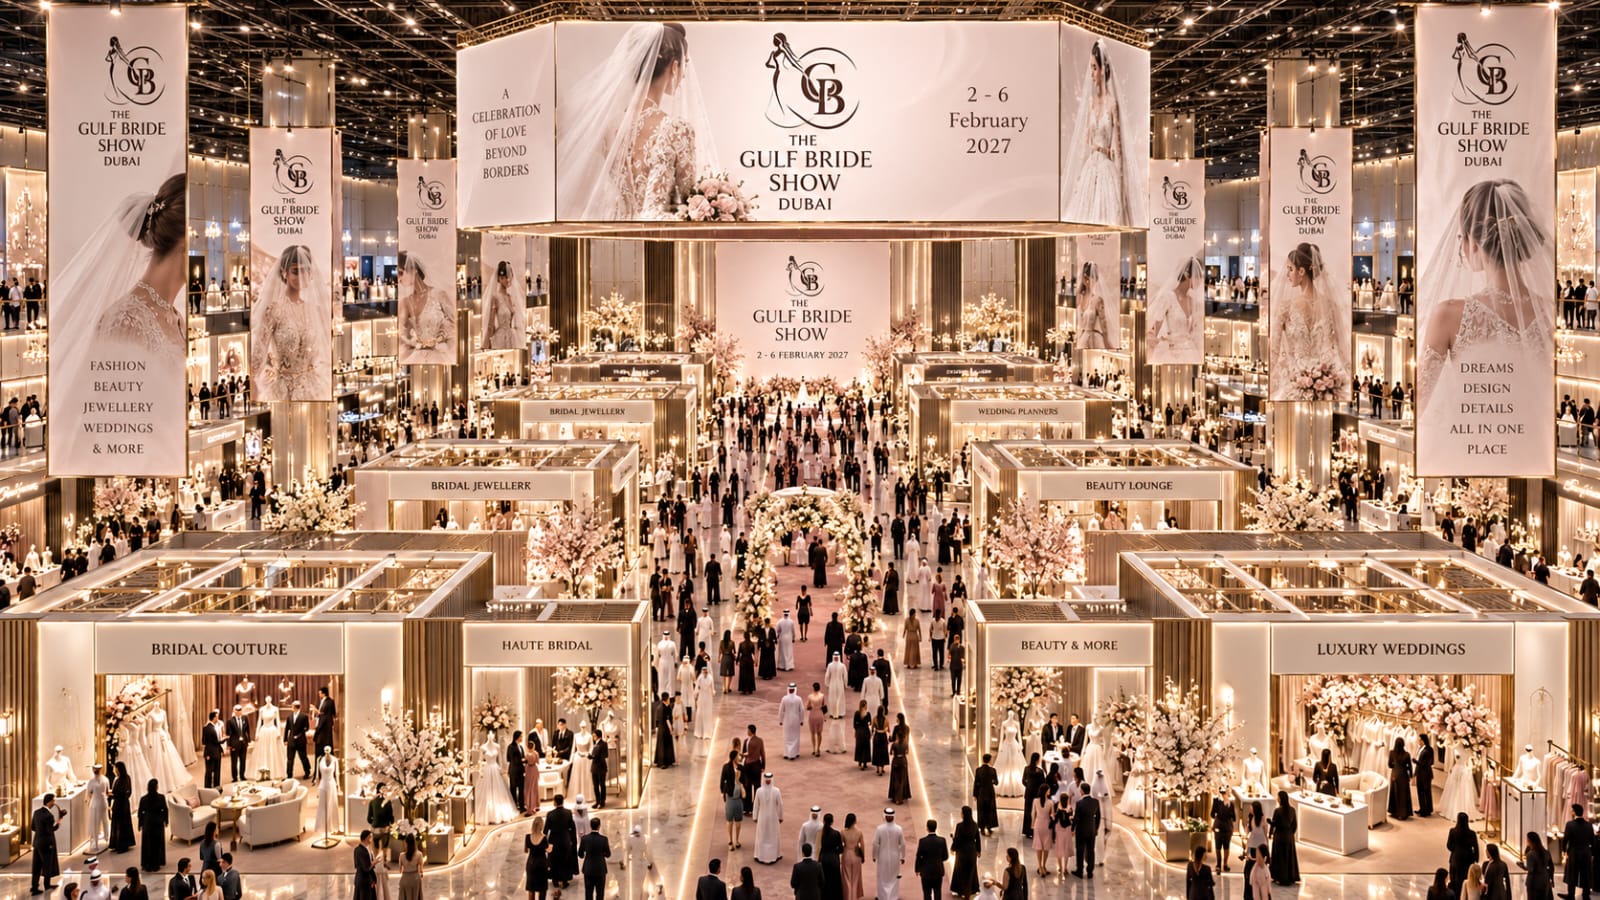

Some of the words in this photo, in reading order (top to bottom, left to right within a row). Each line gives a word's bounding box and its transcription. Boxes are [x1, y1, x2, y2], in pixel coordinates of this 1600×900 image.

[502, 88, 509, 99] A
[968, 87, 977, 102] 2
[998, 87, 1008, 102] 6
[110, 110, 130, 119] THE
[472, 104, 541, 124] CELEBRATION
[1472, 110, 1492, 119] THE
[950, 112, 1028, 132] February
[78, 122, 116, 135] GULF
[122, 122, 166, 135] BRIDE
[485, 129, 498, 141] OF
[501, 125, 527, 139] LOVE
[1438, 122, 1478, 135] GULF
[1484, 122, 1529, 135] BRIDE
[98, 139, 145, 152] SHOW
[789, 135, 816, 146] THE
[966, 138, 1011, 153] 2027
[1458, 139, 1507, 152] SHOW
[486, 145, 526, 160] BEYOND
[104, 156, 140, 166] DUBAI
[740, 151, 798, 168] GULF
[806, 151, 872, 168] BRIDE
[1465, 157, 1502, 166] DUBAI
[484, 164, 529, 179] BORDERS
[770, 174, 840, 191] SHOW
[779, 198, 831, 210] DUBAI
[261, 206, 286, 214] GULF
[290, 206, 319, 214] BRIDE
[1283, 206, 1308, 214] GULF
[1312, 206, 1340, 214] BRIDE
[753, 310, 796, 323] GULF
[803, 310, 852, 323] BRIDE
[776, 328, 828, 341] SHOW
[91, 361, 145, 370] FASHION
[1461, 363, 1514, 373] DREAMS
[94, 382, 143, 392] BEAUTY
[1464, 384, 1510, 393] DESIGN
[83, 402, 153, 414] JEWELLERY
[1462, 404, 1513, 413] DETAILS
[84, 423, 153, 433] WEDDINGS
[1450, 424, 1473, 434] ALL
[1478, 424, 1492, 434] IN
[1497, 424, 1524, 434] ONE
[93, 444, 101, 454] &
[107, 444, 143, 454] MORE
[1468, 444, 1507, 454] PLACE
[432, 482, 470, 490] BRIDAL
[1086, 482, 1126, 490] BEAUTY
[1129, 482, 1172, 490] LOUNGE
[152, 644, 207, 655] BRIDAL
[212, 644, 287, 655] COUTURE
[502, 641, 543, 650] HAUTE
[548, 641, 592, 650] BRIDAL
[1022, 640, 1067, 650] BEAUTY
[1071, 641, 1079, 650] &
[1084, 640, 1118, 650] MORE
[1318, 643, 1377, 655] LUXURY
[1383, 644, 1465, 655] WEDDINGS
